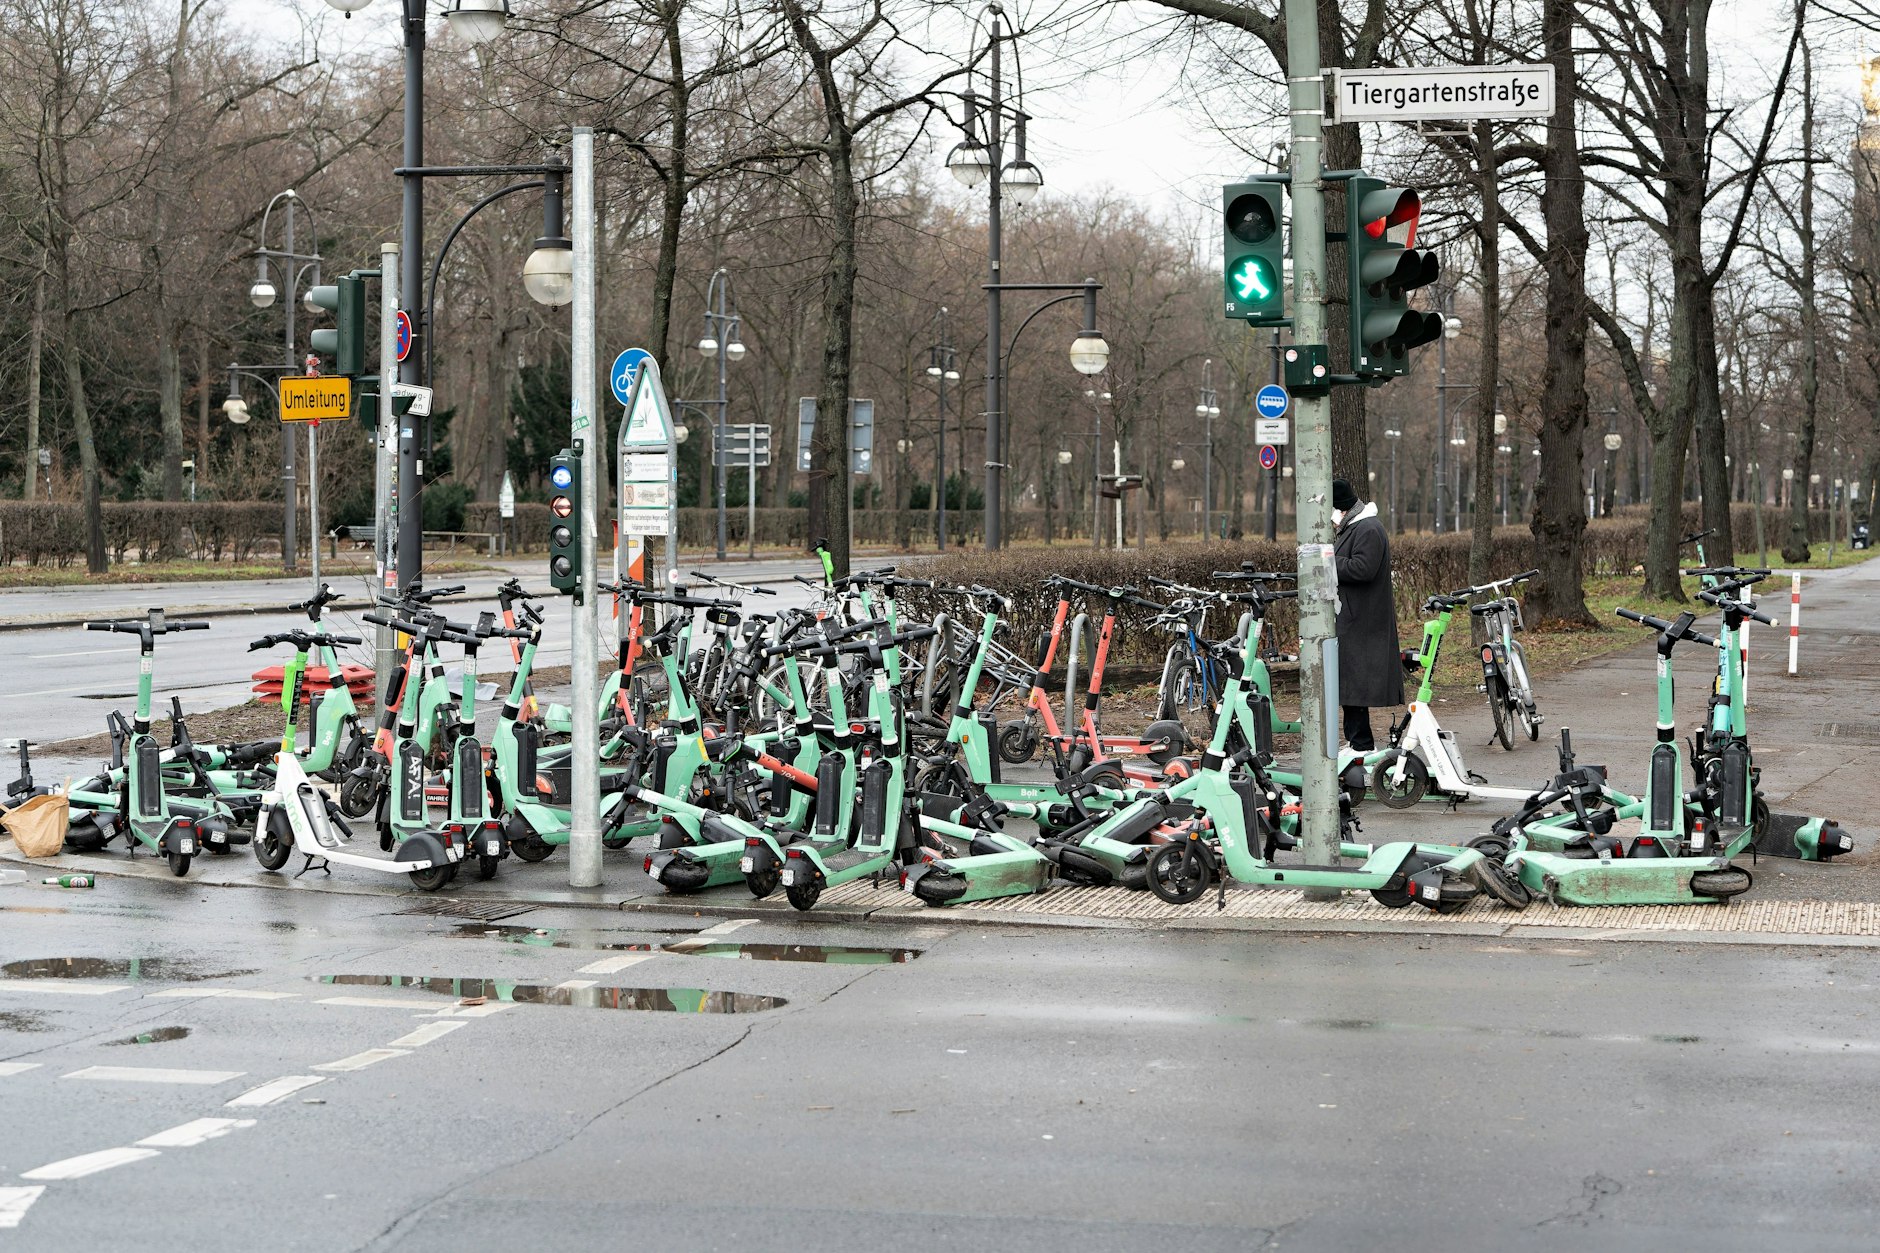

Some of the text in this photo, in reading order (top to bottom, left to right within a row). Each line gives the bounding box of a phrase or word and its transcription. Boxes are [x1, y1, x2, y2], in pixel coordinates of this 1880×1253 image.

[1346, 77, 1540, 108] Tiergartenstraße
[1227, 303, 1234, 311] F5
[284, 389, 345, 412] Umleitung
[1020, 788, 1038, 799] Bolt
[1221, 827, 1235, 848] Bolt
